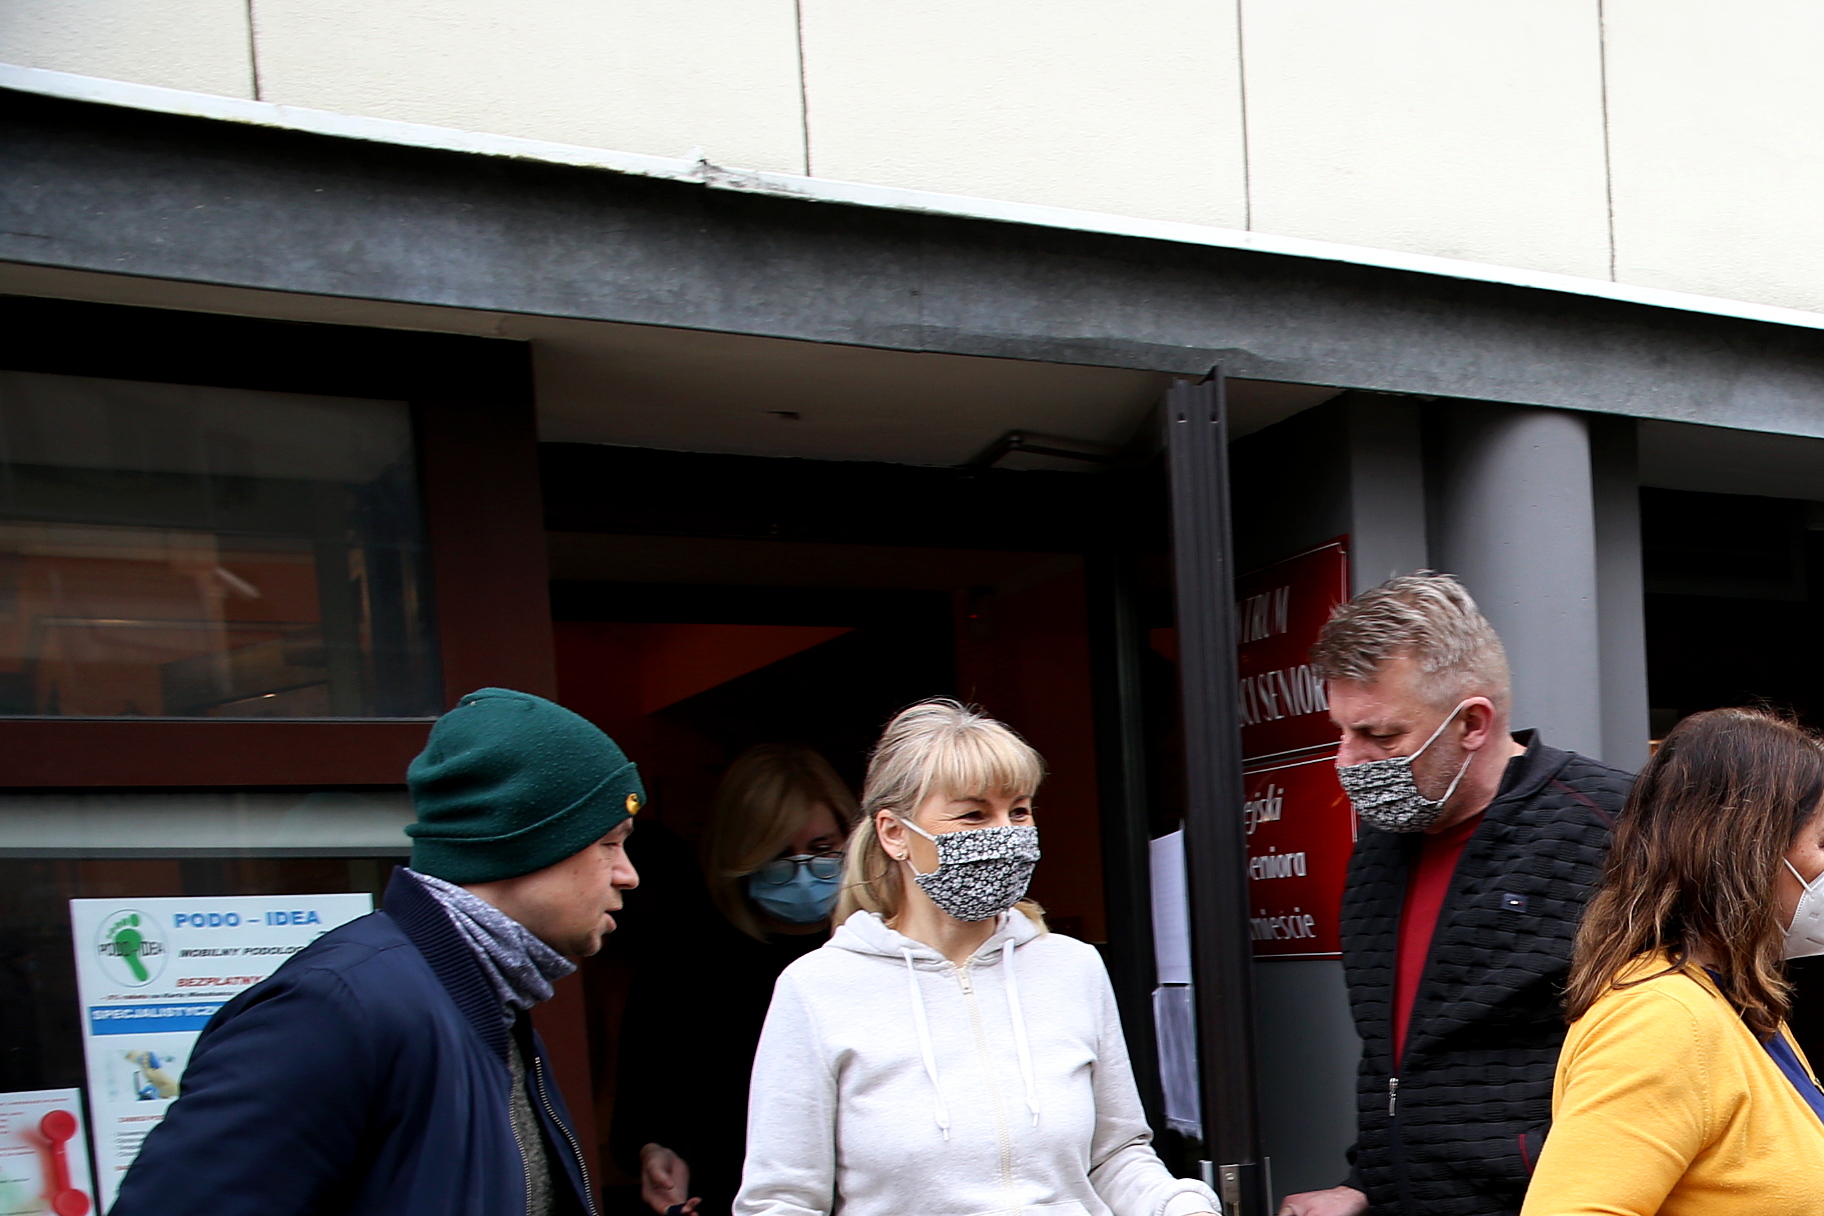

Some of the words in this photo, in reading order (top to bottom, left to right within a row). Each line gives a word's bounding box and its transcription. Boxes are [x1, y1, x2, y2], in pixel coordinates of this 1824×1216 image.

[1234, 585, 1291, 644] TRUM
[1244, 784, 1284, 834] ejski
[1246, 846, 1307, 880] eniora
[174, 912, 241, 928] PODO
[265, 909, 322, 927] IDEA
[178, 948, 239, 959] MOBILNY
